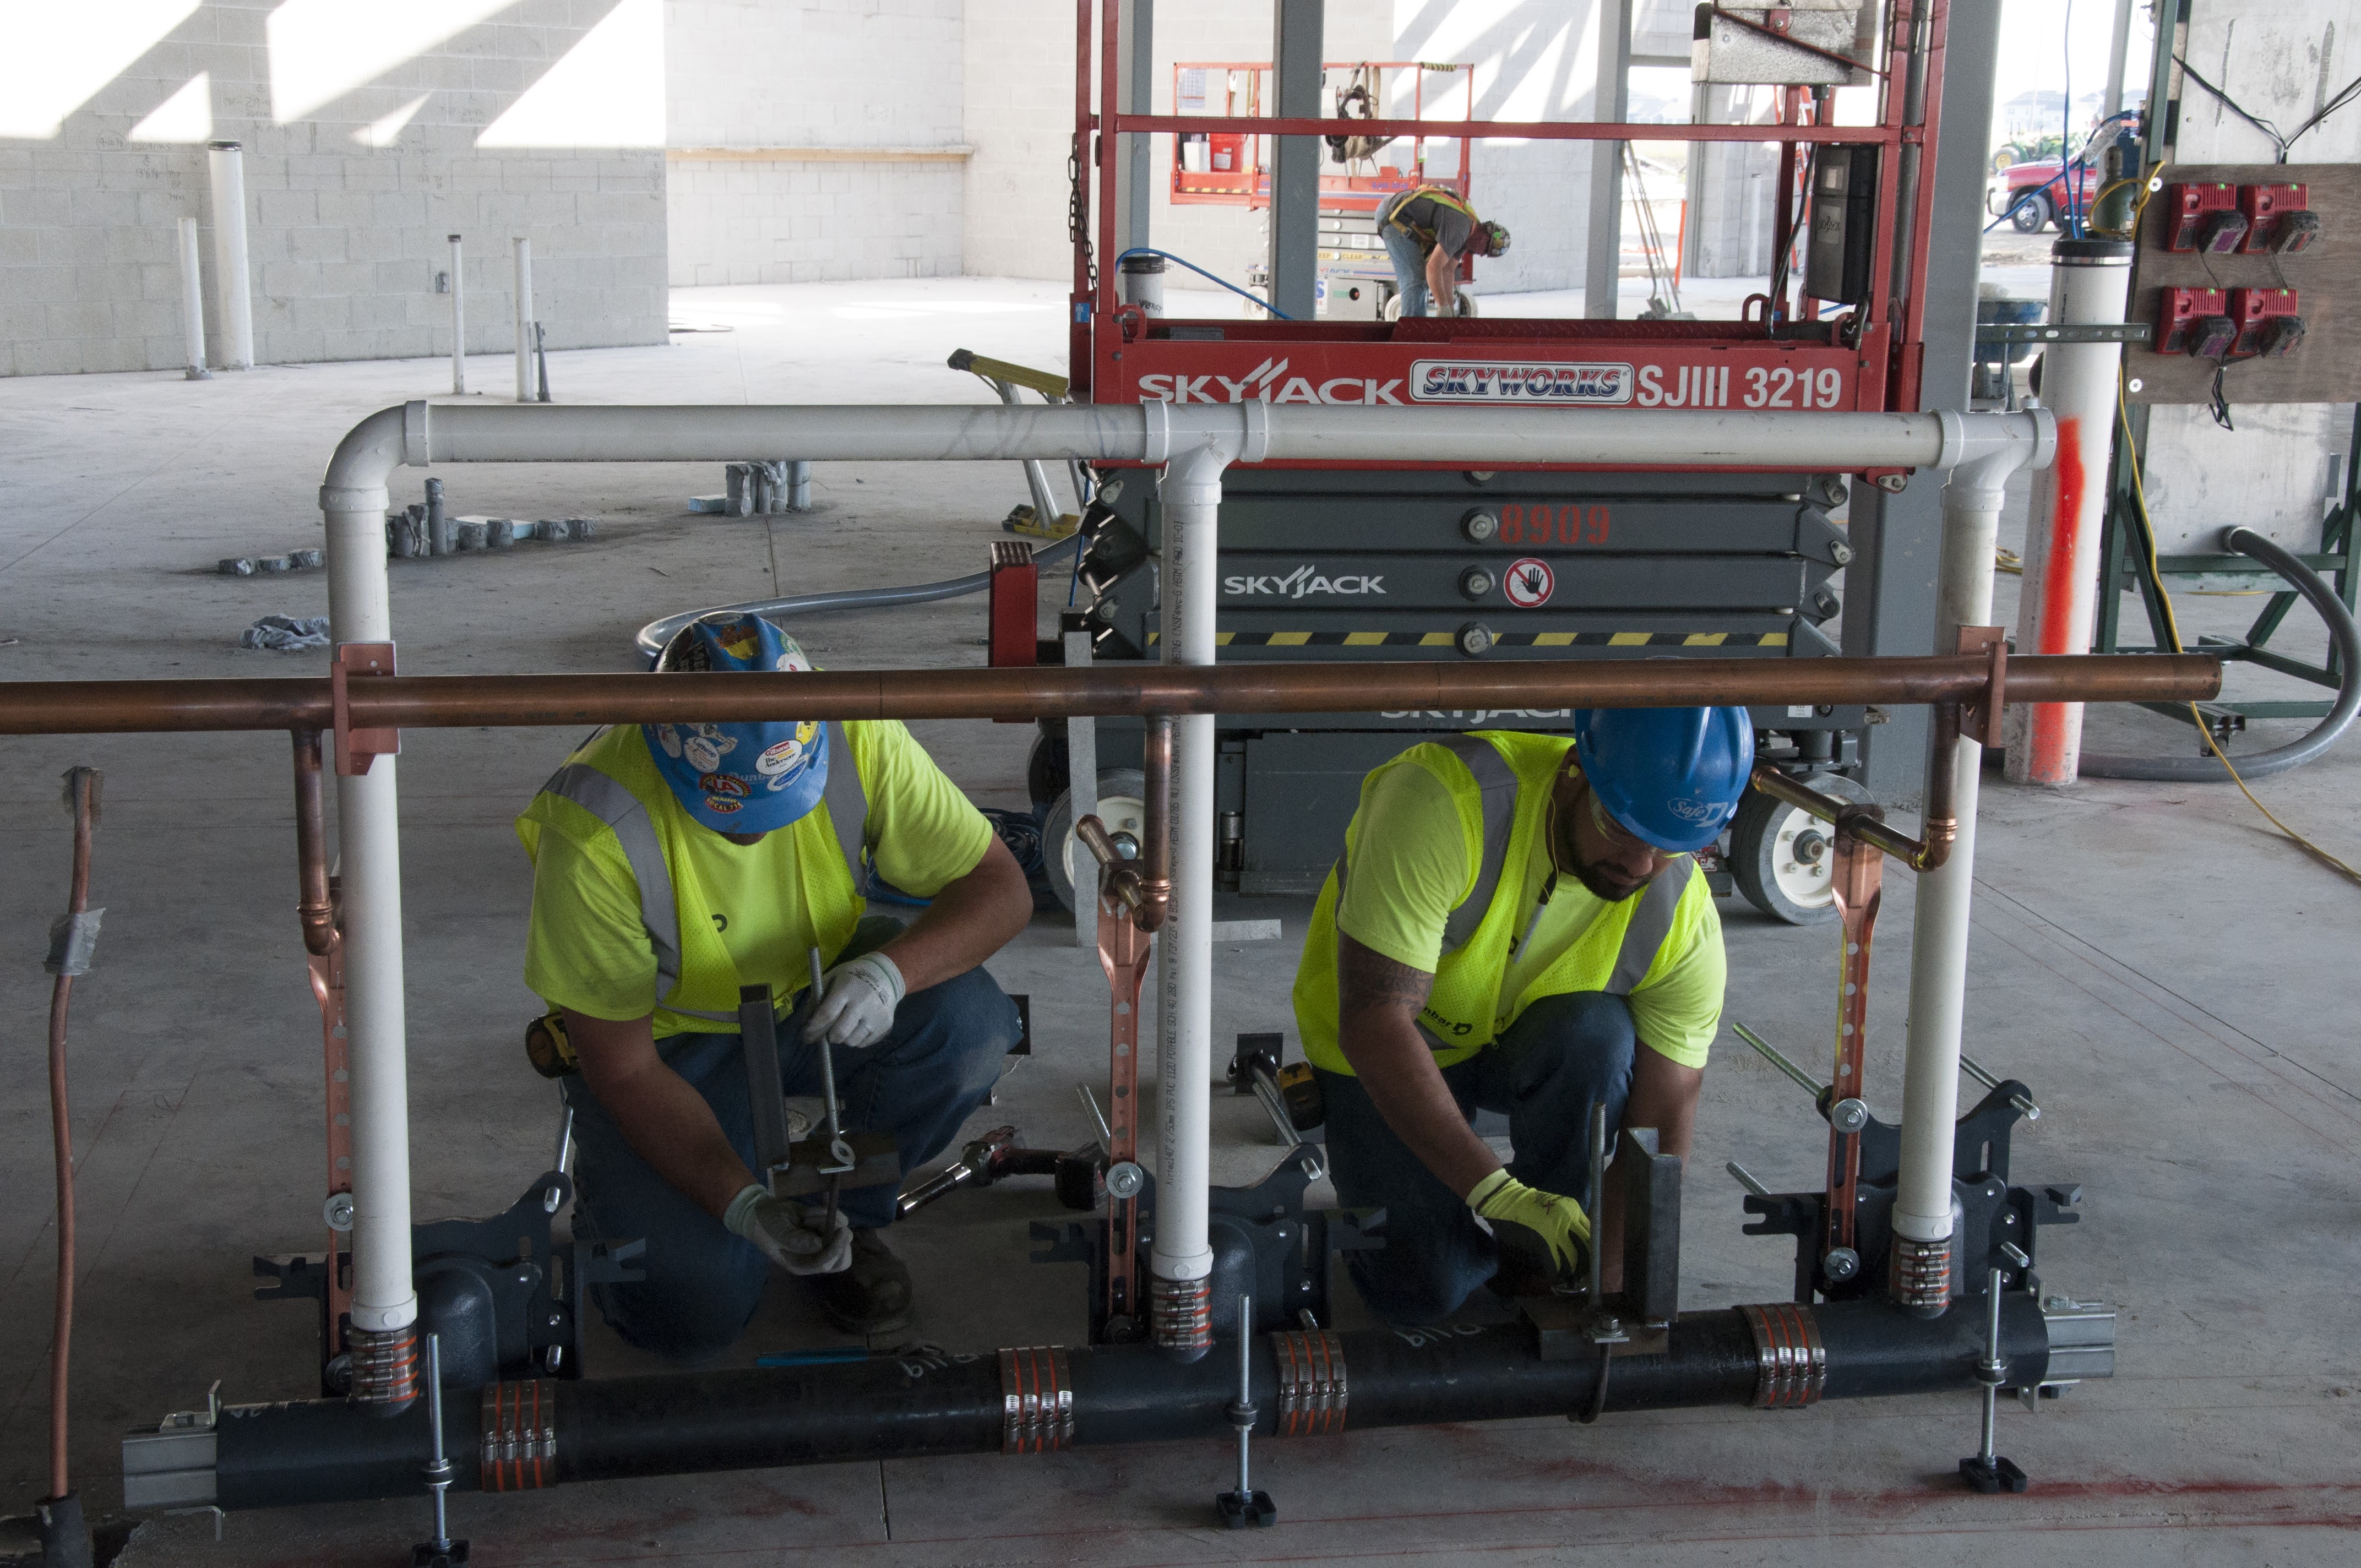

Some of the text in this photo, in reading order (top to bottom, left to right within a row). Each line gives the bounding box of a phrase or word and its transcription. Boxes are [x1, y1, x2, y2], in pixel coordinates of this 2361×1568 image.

[1139, 357, 1841, 409] SKYJACK SKYWORKS SJIII 3219
[1500, 504, 1610, 545] 8909
[1173, 568, 1182, 587] ASTM
[1224, 564, 1387, 599] SKYJACK
[765, 744, 790, 756] Gilbane
[765, 753, 796, 768] Andersons
[707, 798, 727, 810] LOCAL
[1674, 801, 1705, 818] Safe
[1169, 827, 1179, 846] ASTM
[1167, 999, 1176, 1009] 40
[1166, 1012, 1176, 1026] SCH
[1423, 1006, 1451, 1027] nbar
[1166, 1029, 1176, 1060] POTABLE
[1166, 1062, 1176, 1079] 1120
[1166, 1098, 1175, 1111] IPS
